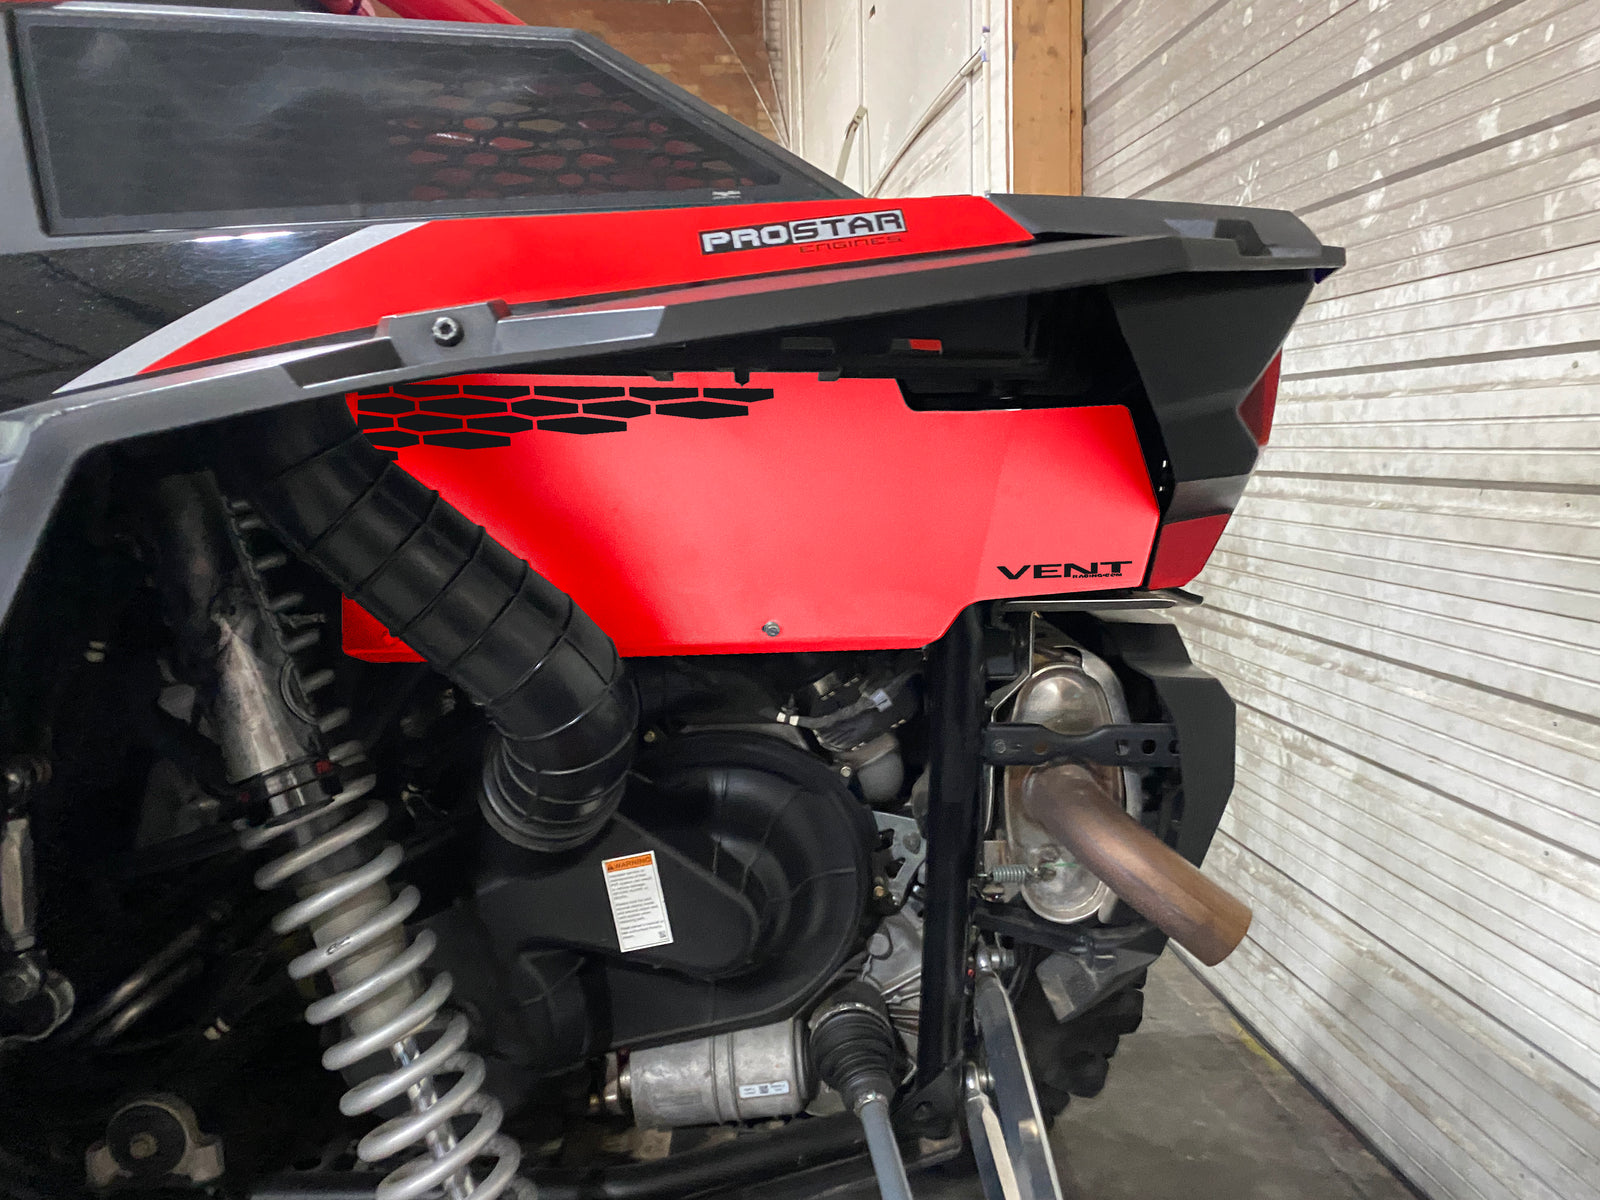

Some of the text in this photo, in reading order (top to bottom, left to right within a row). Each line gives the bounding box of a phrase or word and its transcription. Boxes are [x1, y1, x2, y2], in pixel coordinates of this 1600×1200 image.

[701, 212, 903, 253] PROSTAR
[800, 236, 902, 253] ENGINES
[997, 561, 1132, 579] VENT
[614, 857, 651, 869] WARNING
